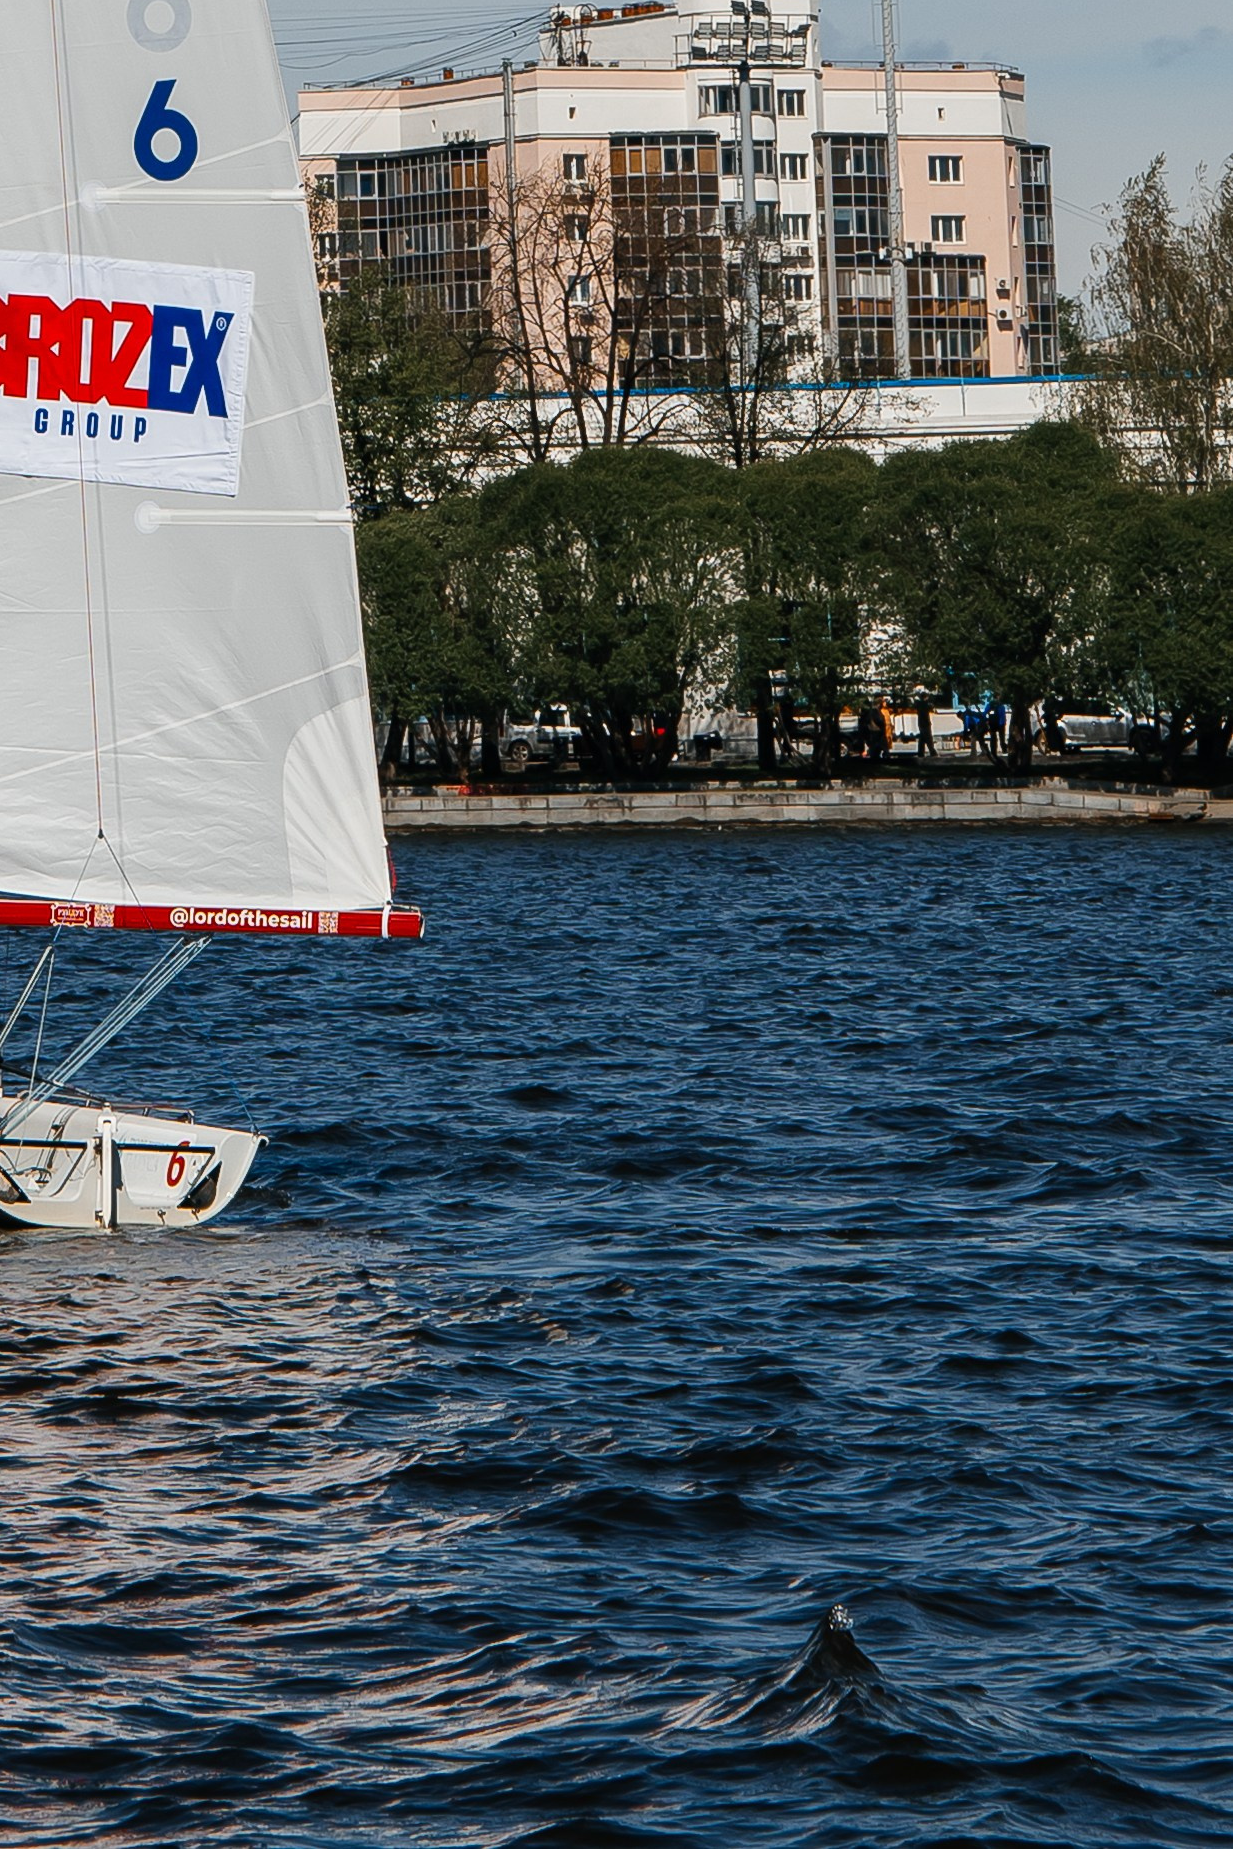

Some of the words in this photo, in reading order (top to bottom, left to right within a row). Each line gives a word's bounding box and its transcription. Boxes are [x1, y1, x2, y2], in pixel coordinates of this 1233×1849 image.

[134, 78, 198, 181] 6
[34, 408, 147, 443] GROUP
[169, 907, 313, 929] @lordofthesail
[167, 1141, 191, 1187] 6
